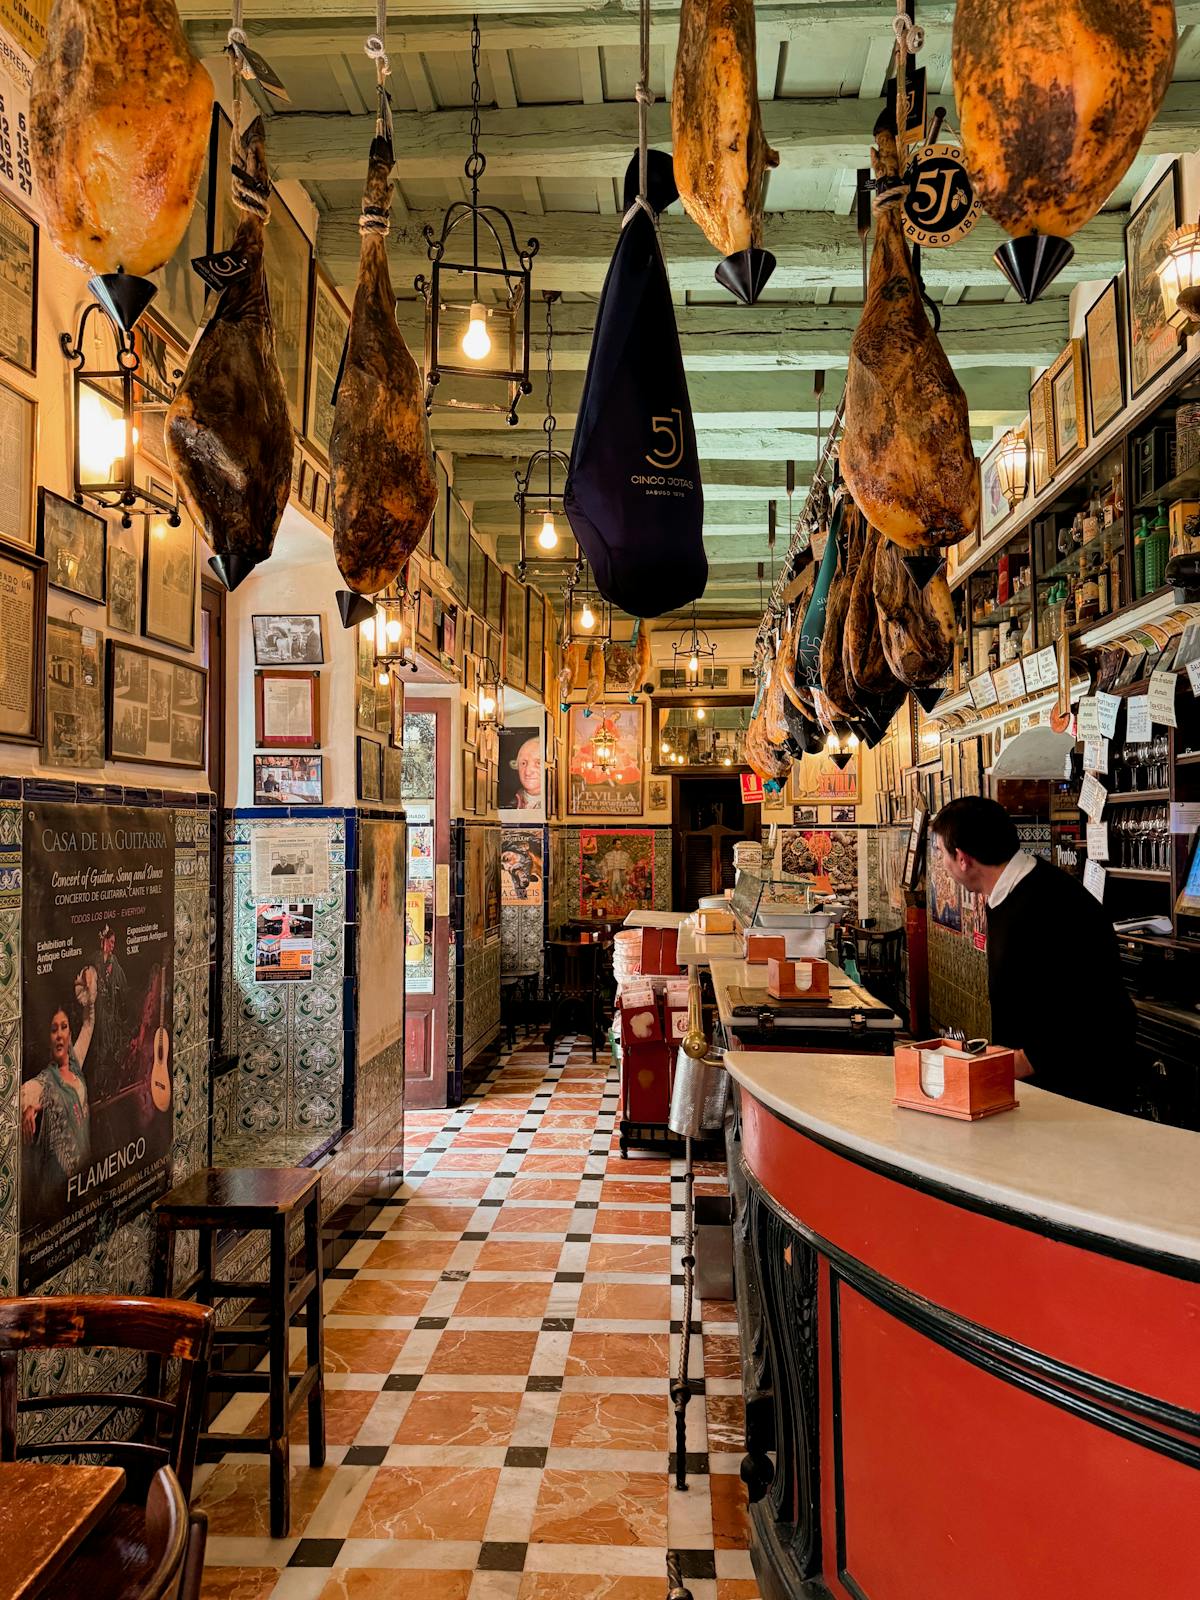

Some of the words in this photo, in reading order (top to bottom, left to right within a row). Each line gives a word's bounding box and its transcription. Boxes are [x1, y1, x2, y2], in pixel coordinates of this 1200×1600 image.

[18, 112, 26, 132] 6
[17, 131, 29, 156] 13
[17, 150, 32, 177] 20
[0, 155, 14, 181] 26
[19, 172, 33, 197] 27
[912, 168, 960, 225] 5J
[645, 407, 684, 469] 5J
[630, 475, 665, 485] CINCO
[667, 477, 694, 490] JOTAS
[577, 791, 635, 801] SEVILLA
[41, 829, 77, 852] CASA
[81, 832, 98, 851] DE
[101, 832, 114, 850] LA
[114, 829, 167, 851] GUITARRA
[1055, 844, 1078, 868] Protos
[51, 870, 80, 888] Concert
[81, 867, 91, 891] of
[116, 867, 134, 889] Song
[133, 863, 148, 881] and
[54, 891, 91, 906] CONCIERTO
[91, 889, 100, 902] DE
[128, 886, 145, 898] CANTE
[145, 886, 150, 896] Y
[149, 884, 162, 895] BAILE
[71, 914, 91, 924] TODOS
[91, 911, 103, 922] LOS
[121, 906, 146, 917] EVERYDAY
[152, 922, 159, 931] de
[37, 938, 66, 952] Exhibition
[66, 936, 74, 947] of
[126, 934, 149, 946] Guitarras
[126, 945, 140, 956] S.XIX
[37, 951, 61, 965] Antique
[60, 946, 83, 959] Guitars
[37, 963, 54, 976] S.XIX
[67, 1136, 146, 1203] FLAMENCO
[30, 1242, 55, 1265] Entradas
